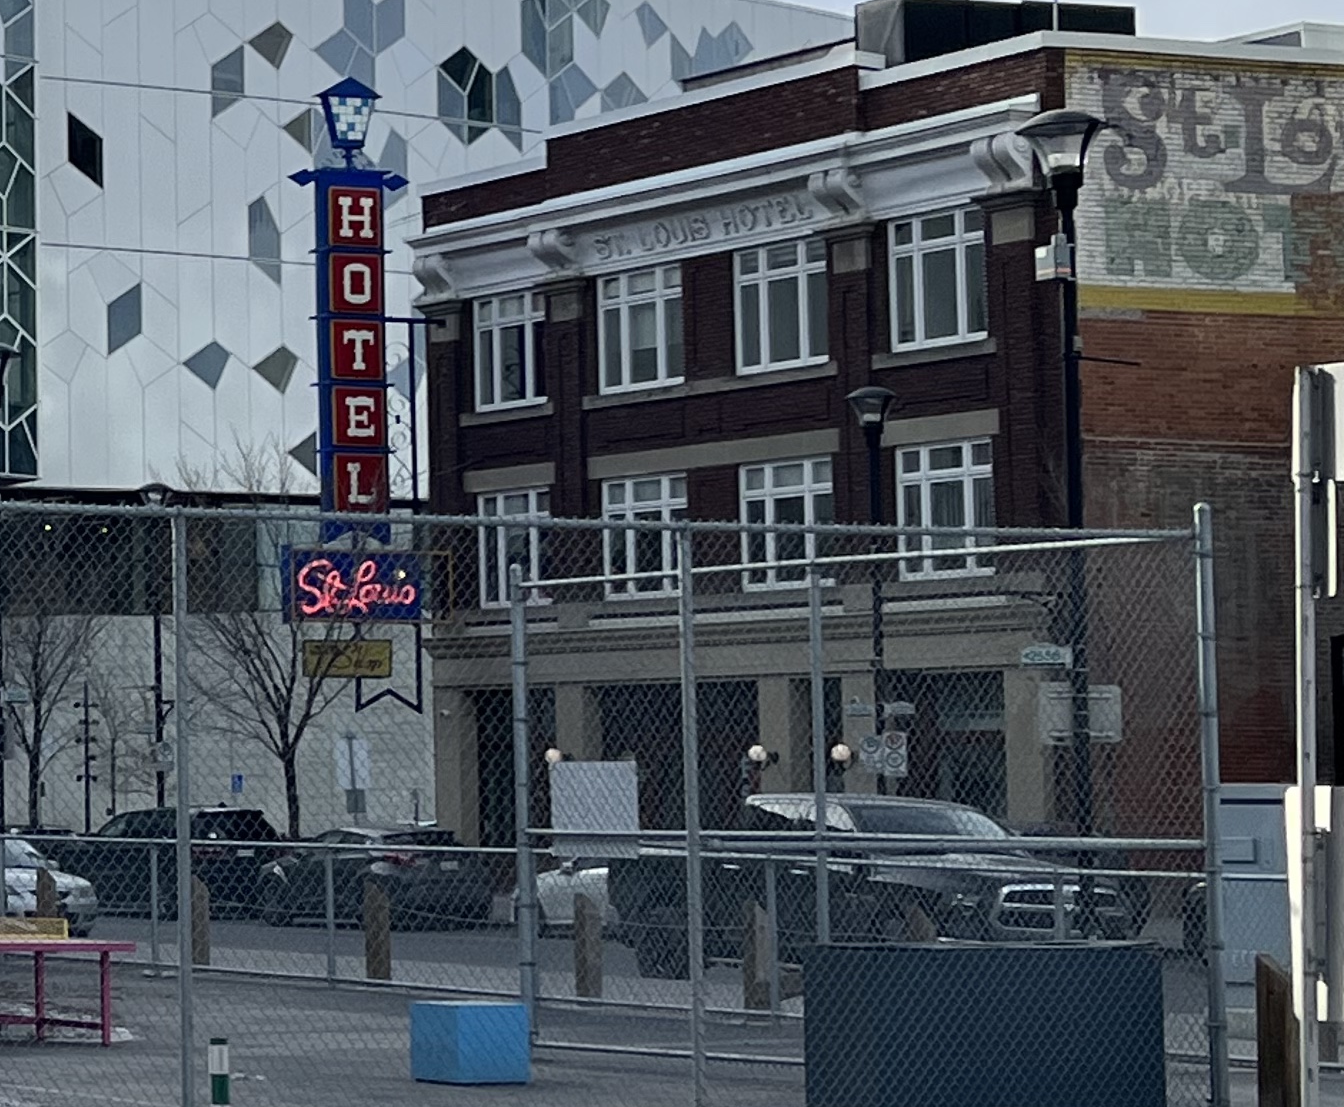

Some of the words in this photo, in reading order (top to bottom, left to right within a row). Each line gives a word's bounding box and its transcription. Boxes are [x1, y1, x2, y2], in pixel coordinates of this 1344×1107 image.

[594, 233, 632, 260] ST.
[637, 216, 711, 252] LOUIS
[720, 195, 814, 235] HOTEL
[338, 195, 376, 505] HOTEL
